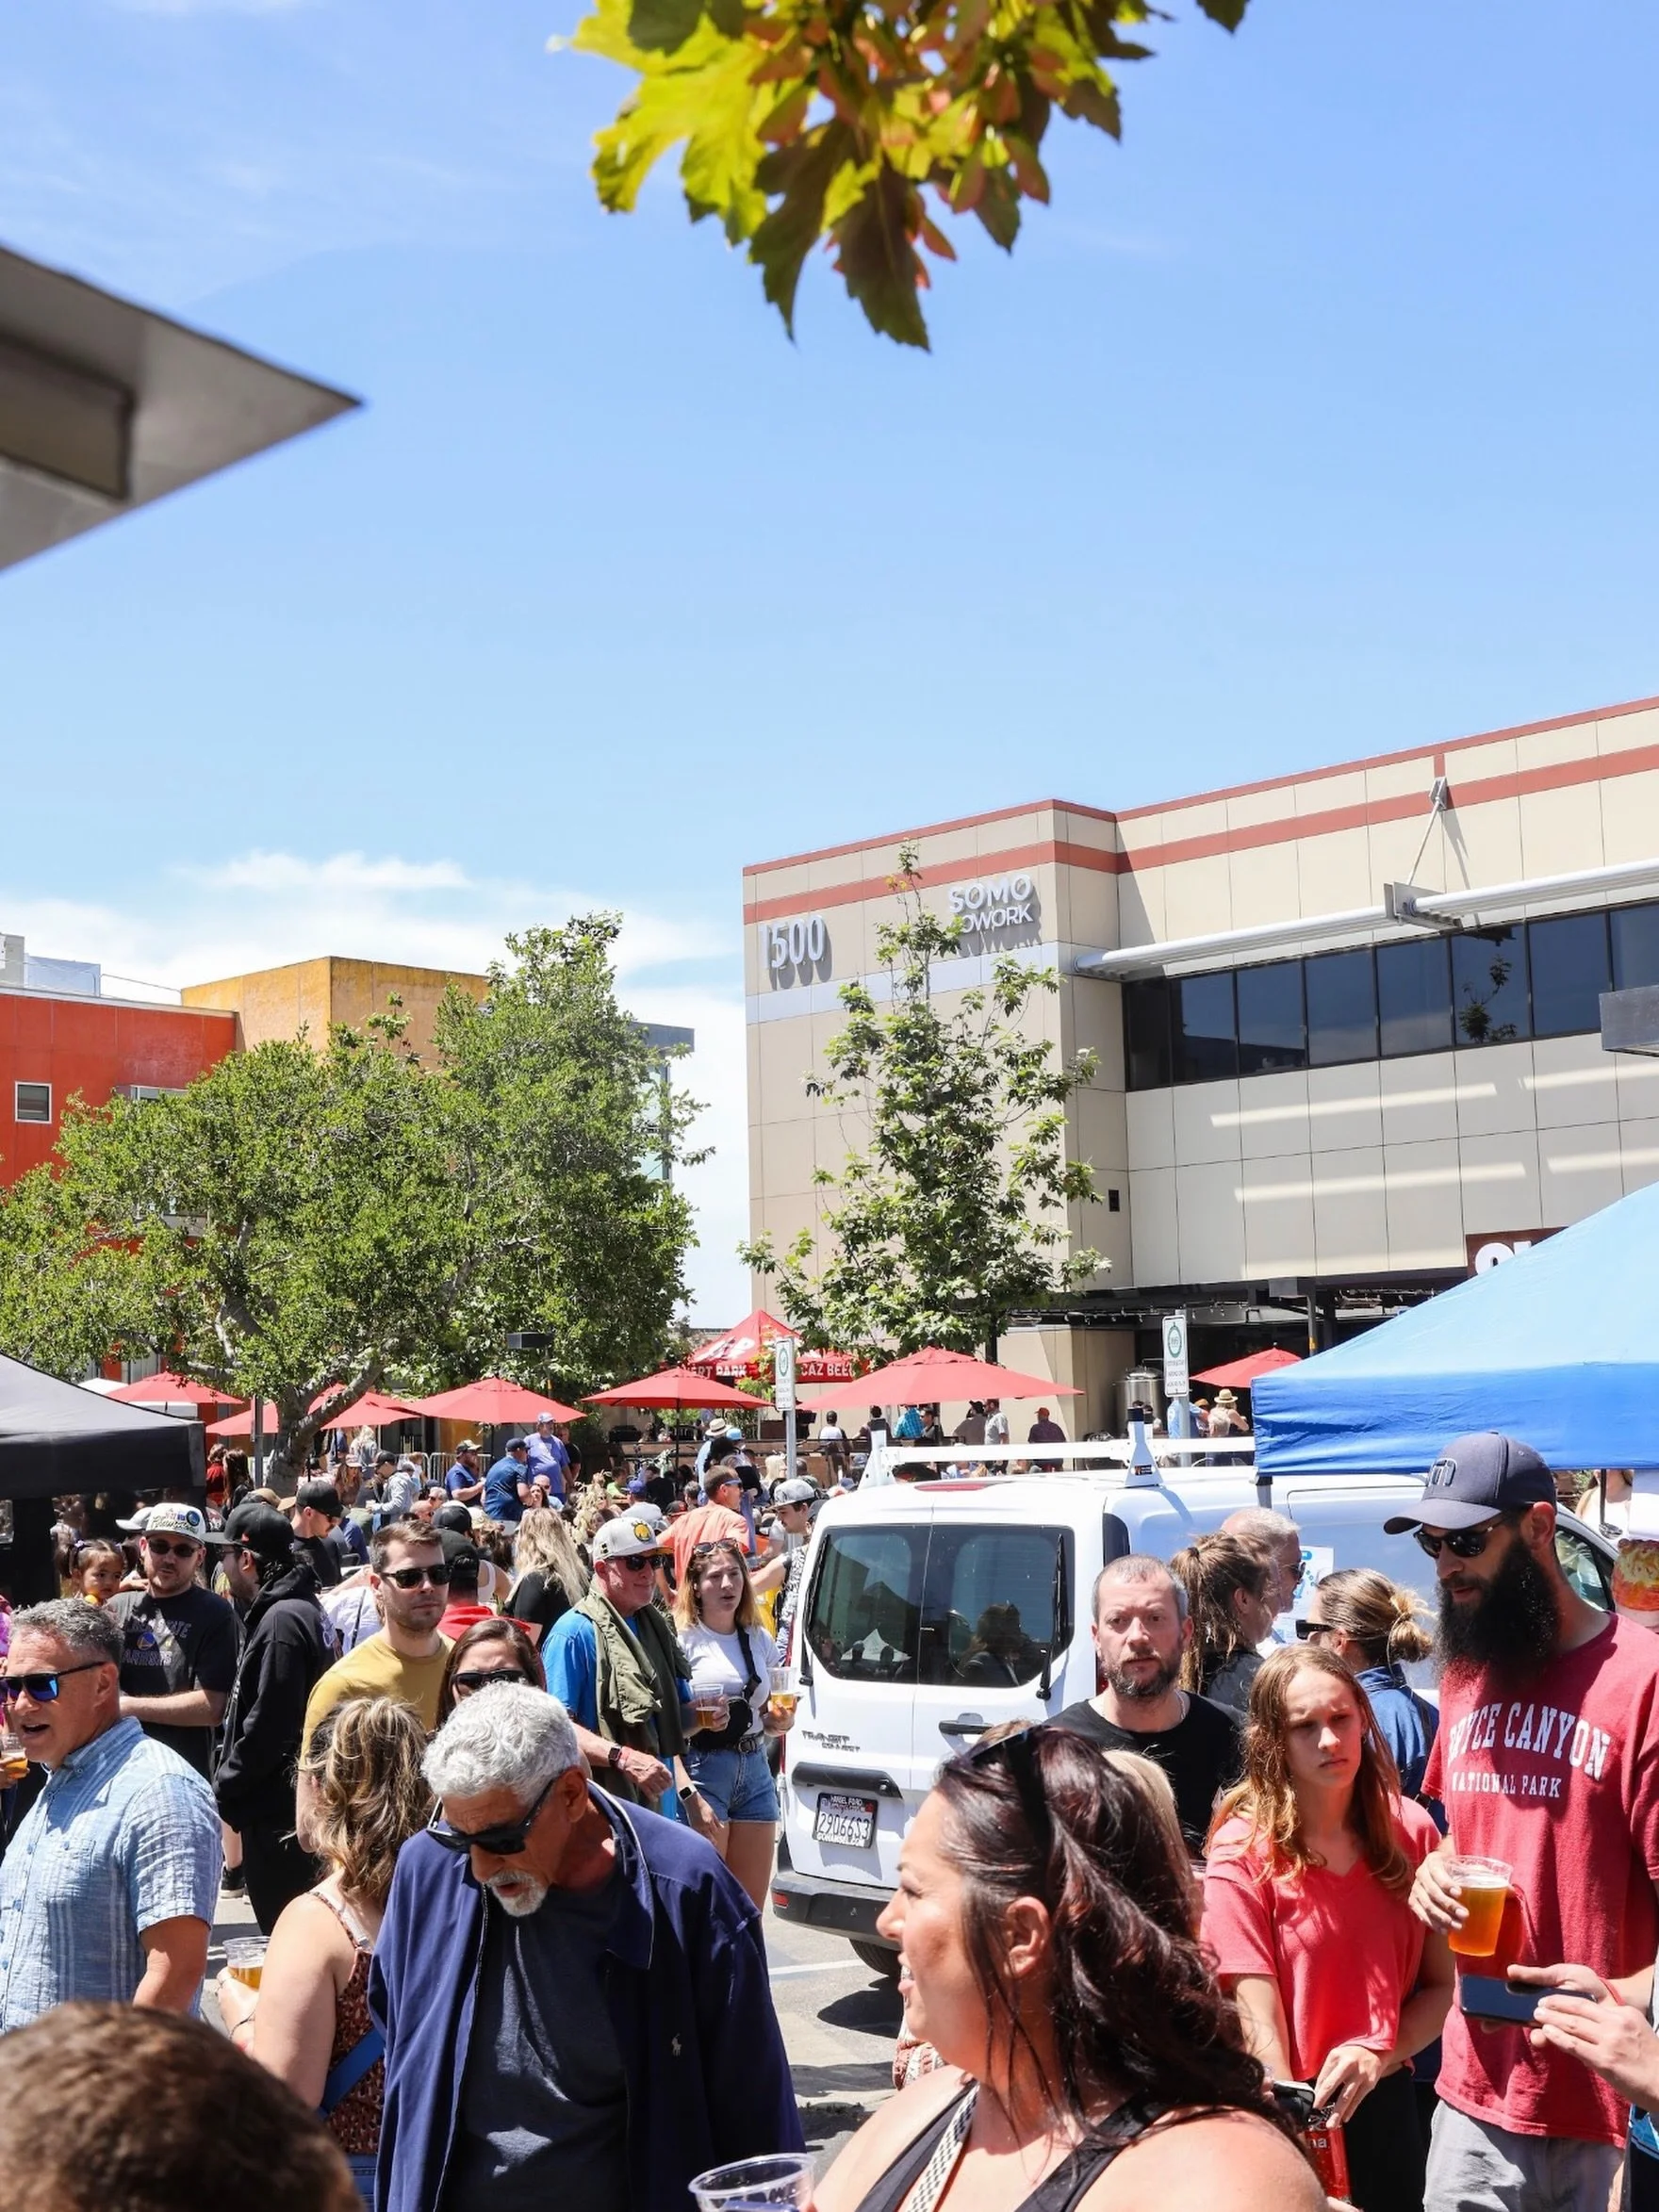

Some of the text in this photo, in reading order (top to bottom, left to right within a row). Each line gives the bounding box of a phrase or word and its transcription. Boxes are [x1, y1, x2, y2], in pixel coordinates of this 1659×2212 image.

[948, 874, 1032, 913] SOMO
[950, 902, 1034, 933] OWORK
[758, 914, 824, 969] 1500
[1503, 1702, 1611, 1780] CANYON
[1520, 1774, 1562, 1798] PARK
